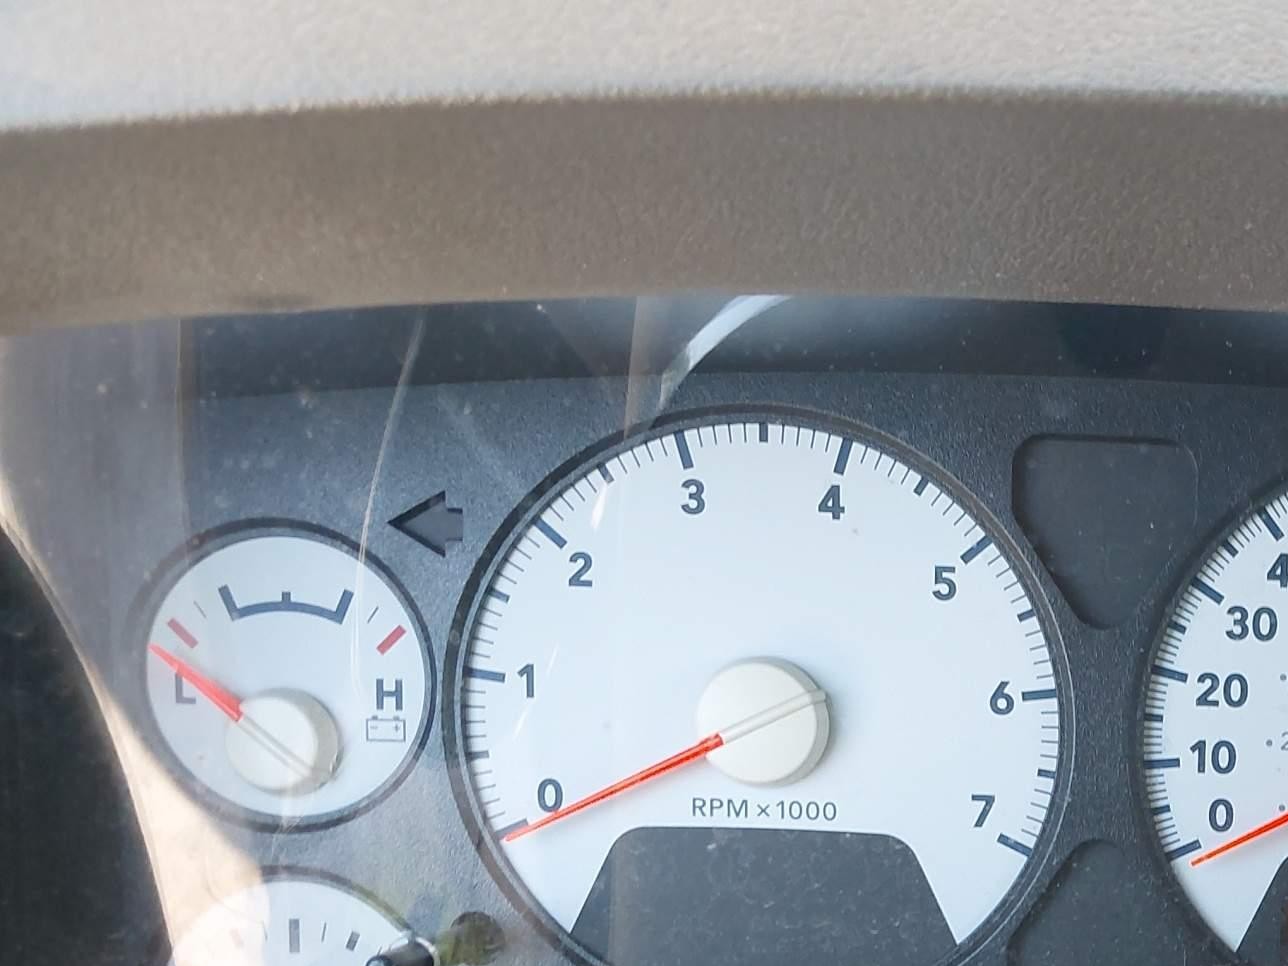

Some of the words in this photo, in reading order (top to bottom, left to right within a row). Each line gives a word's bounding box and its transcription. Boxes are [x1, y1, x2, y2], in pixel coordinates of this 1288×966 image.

[680, 478, 706, 515] 3
[817, 484, 846, 521] 4
[568, 551, 593, 588] 2
[931, 565, 957, 601] 5
[1225, 605, 1278, 642] 30
[174, 671, 197, 705] L
[375, 678, 404, 712] H
[517, 663, 535, 699] 1
[989, 680, 1015, 716] 6
[1195, 672, 1249, 708] 20
[1189, 739, 1237, 775] 10
[537, 778, 564, 813] 0
[692, 797, 749, 819] RPM
[971, 794, 996, 828] 7
[1208, 798, 1234, 833] 0
